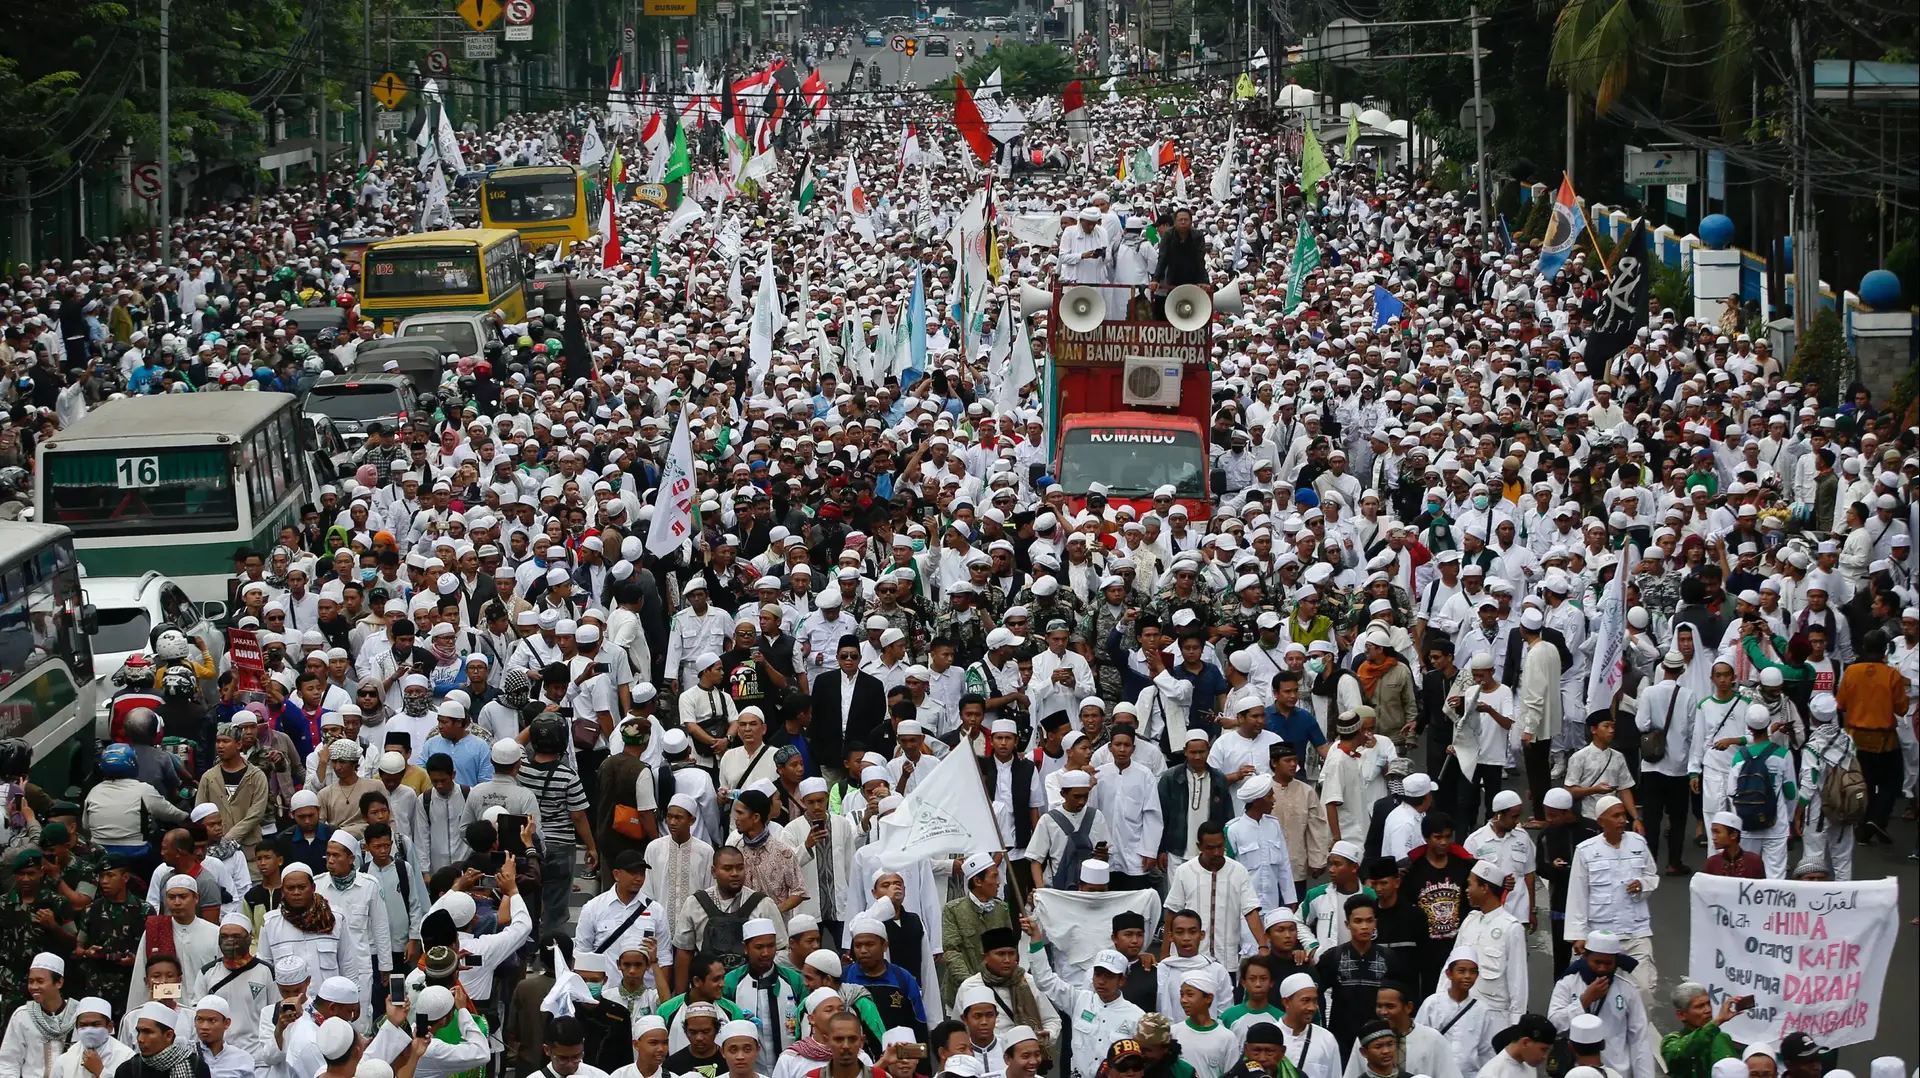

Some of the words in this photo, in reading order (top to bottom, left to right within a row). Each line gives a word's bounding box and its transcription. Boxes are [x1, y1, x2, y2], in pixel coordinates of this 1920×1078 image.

[489, 191, 506, 200] 102
[376, 263, 394, 275] 102
[1059, 324, 1103, 342] HUKUM
[1138, 326, 1206, 345] KORUPTOR
[1058, 343, 1082, 360] DAN
[1086, 344, 1139, 362] BANDAR
[1144, 345, 1206, 364] NARKOBA
[1090, 428, 1176, 444] KOMANDO
[119, 458, 157, 486] 16
[233, 637, 258, 647] JAKARTA
[235, 649, 260, 660] AHOK
[1798, 939, 1861, 972] KAFIR
[1783, 971, 1862, 1006] DARAH
